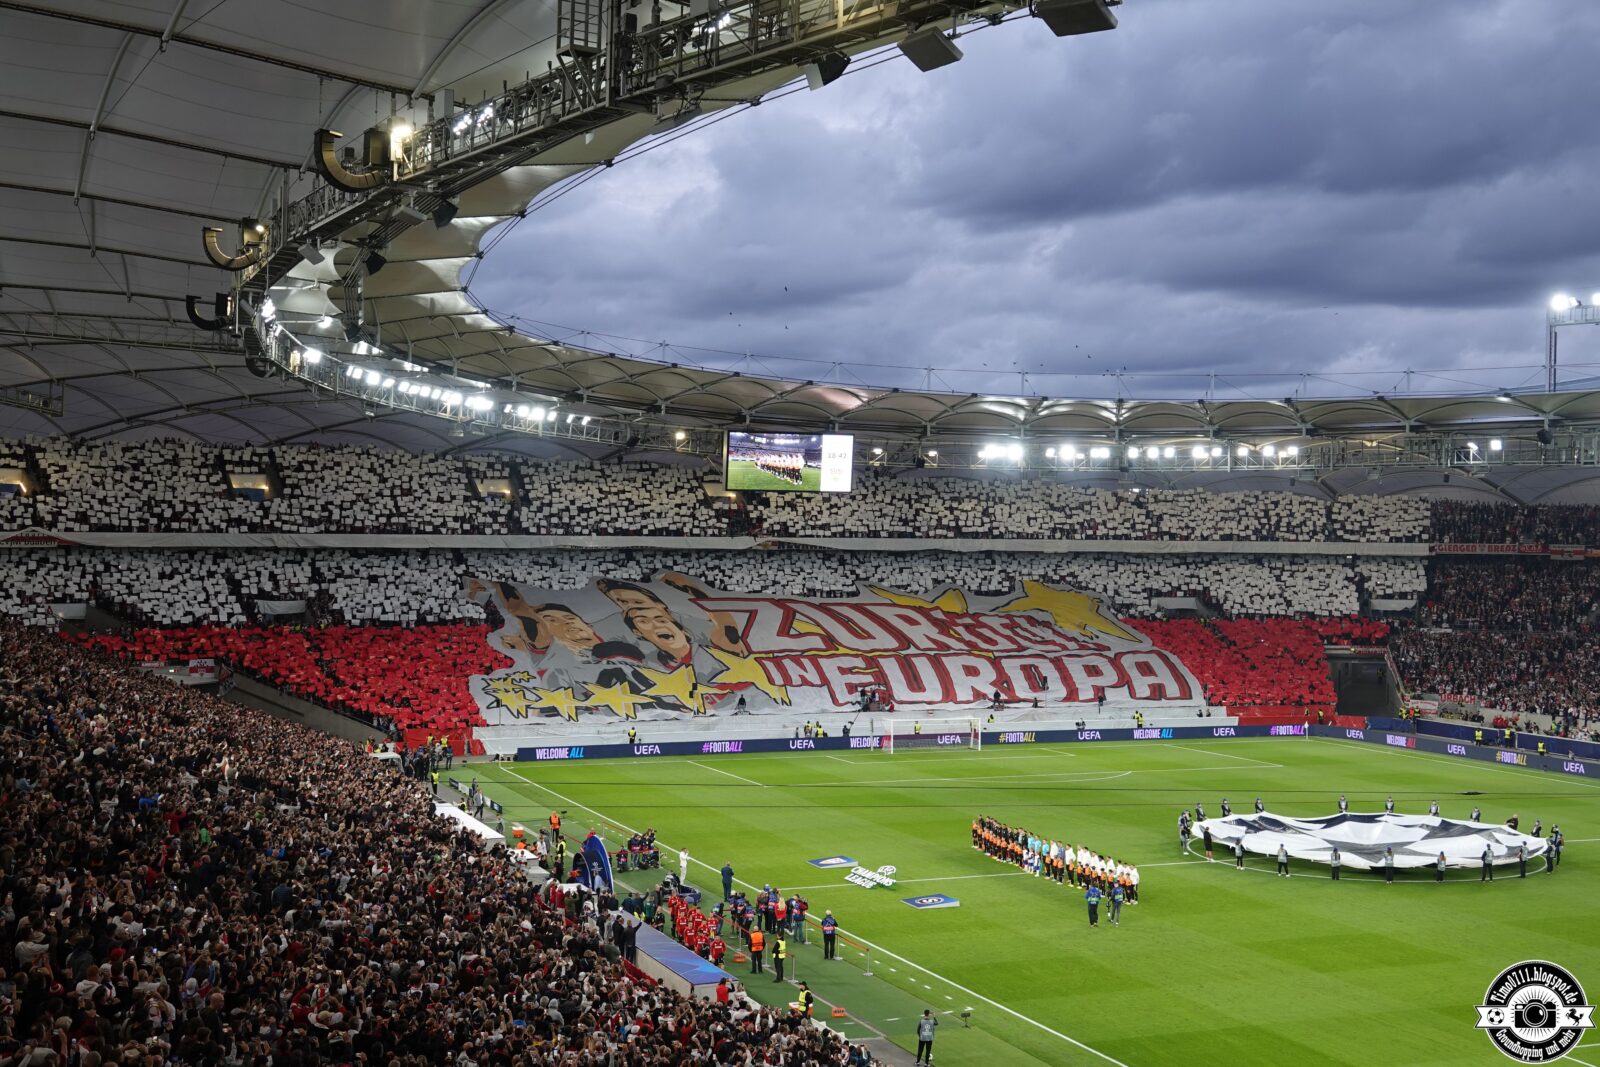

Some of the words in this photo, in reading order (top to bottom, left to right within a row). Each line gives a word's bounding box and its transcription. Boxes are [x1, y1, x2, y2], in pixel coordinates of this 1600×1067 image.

[755, 654, 827, 688] IN
[815, 649, 1193, 707] EUROPA
[1440, 693, 1476, 705] URBACH
[1078, 730, 1101, 741] UEFA
[1133, 728, 1161, 740] WELCOME
[1161, 727, 1173, 739] ALL
[1213, 727, 1235, 737] UEFA
[1270, 725, 1304, 736] #FOOTBALL
[1346, 729, 1364, 740] UEFA
[937, 734, 962, 745] UEFA
[998, 731, 1036, 744] #FOOTBALL
[1386, 734, 1407, 747] WELCOME
[1407, 736, 1417, 749] ALL
[634, 744, 661, 755] UEFA
[702, 741, 743, 753] #FOOTBALL
[789, 739, 815, 749] UEFA
[1447, 743, 1466, 756] UEFA
[535, 747, 569, 760] WELCOME
[569, 746, 585, 759] ALL
[1496, 750, 1527, 766] #FOOTBALL
[1563, 760, 1585, 774] UEFA
